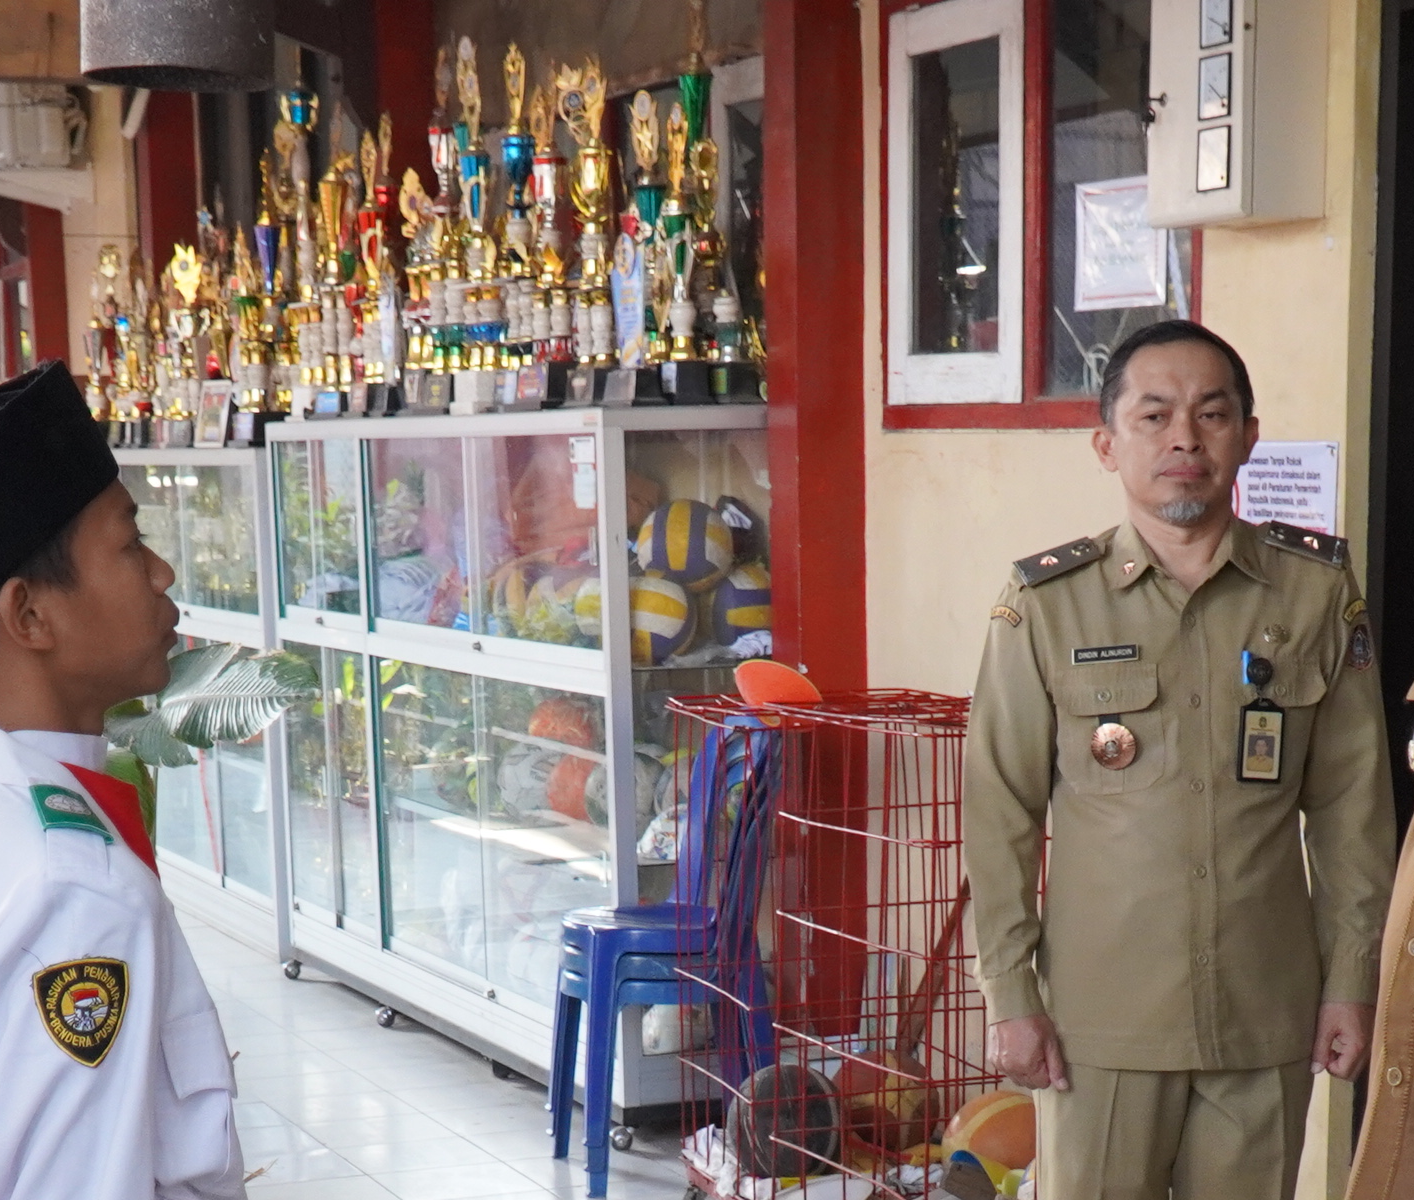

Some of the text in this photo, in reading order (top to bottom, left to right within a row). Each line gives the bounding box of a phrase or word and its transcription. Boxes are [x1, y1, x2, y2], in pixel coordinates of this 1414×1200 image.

[46, 965, 120, 1010] PASUKAN PENGIBAR
[49, 1008, 119, 1048] BENDERA PUSAKA
